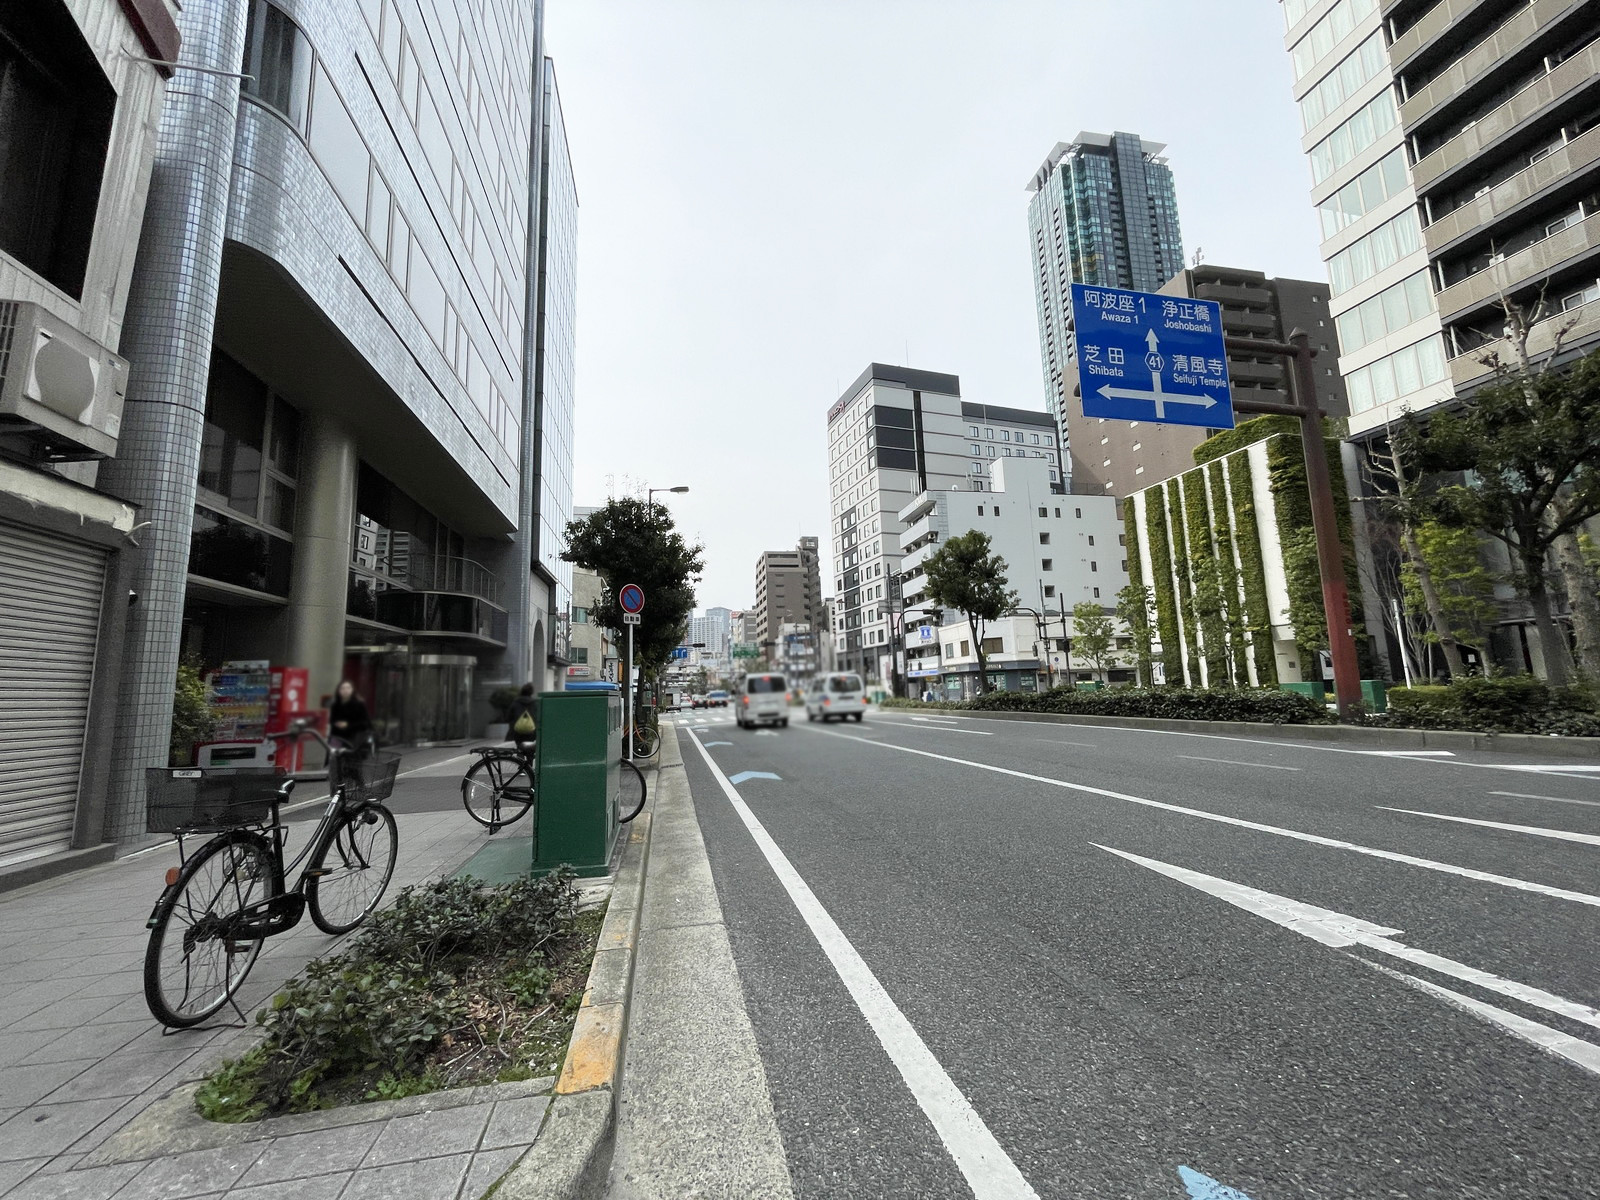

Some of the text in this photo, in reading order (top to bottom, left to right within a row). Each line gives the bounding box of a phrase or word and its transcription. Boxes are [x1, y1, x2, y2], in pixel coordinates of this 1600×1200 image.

[1101, 312, 1139, 324] Awaza 1
[1162, 300, 1210, 322] 浄正橋
[1164, 320, 1212, 333] Joshobashi
[1084, 344, 1125, 365] 芝田
[1149, 356, 1161, 368] 41
[1172, 354, 1224, 376] 清風寺
[1088, 365, 1124, 377] Shibata
[1173, 373, 1227, 389] Seifuji Temple
